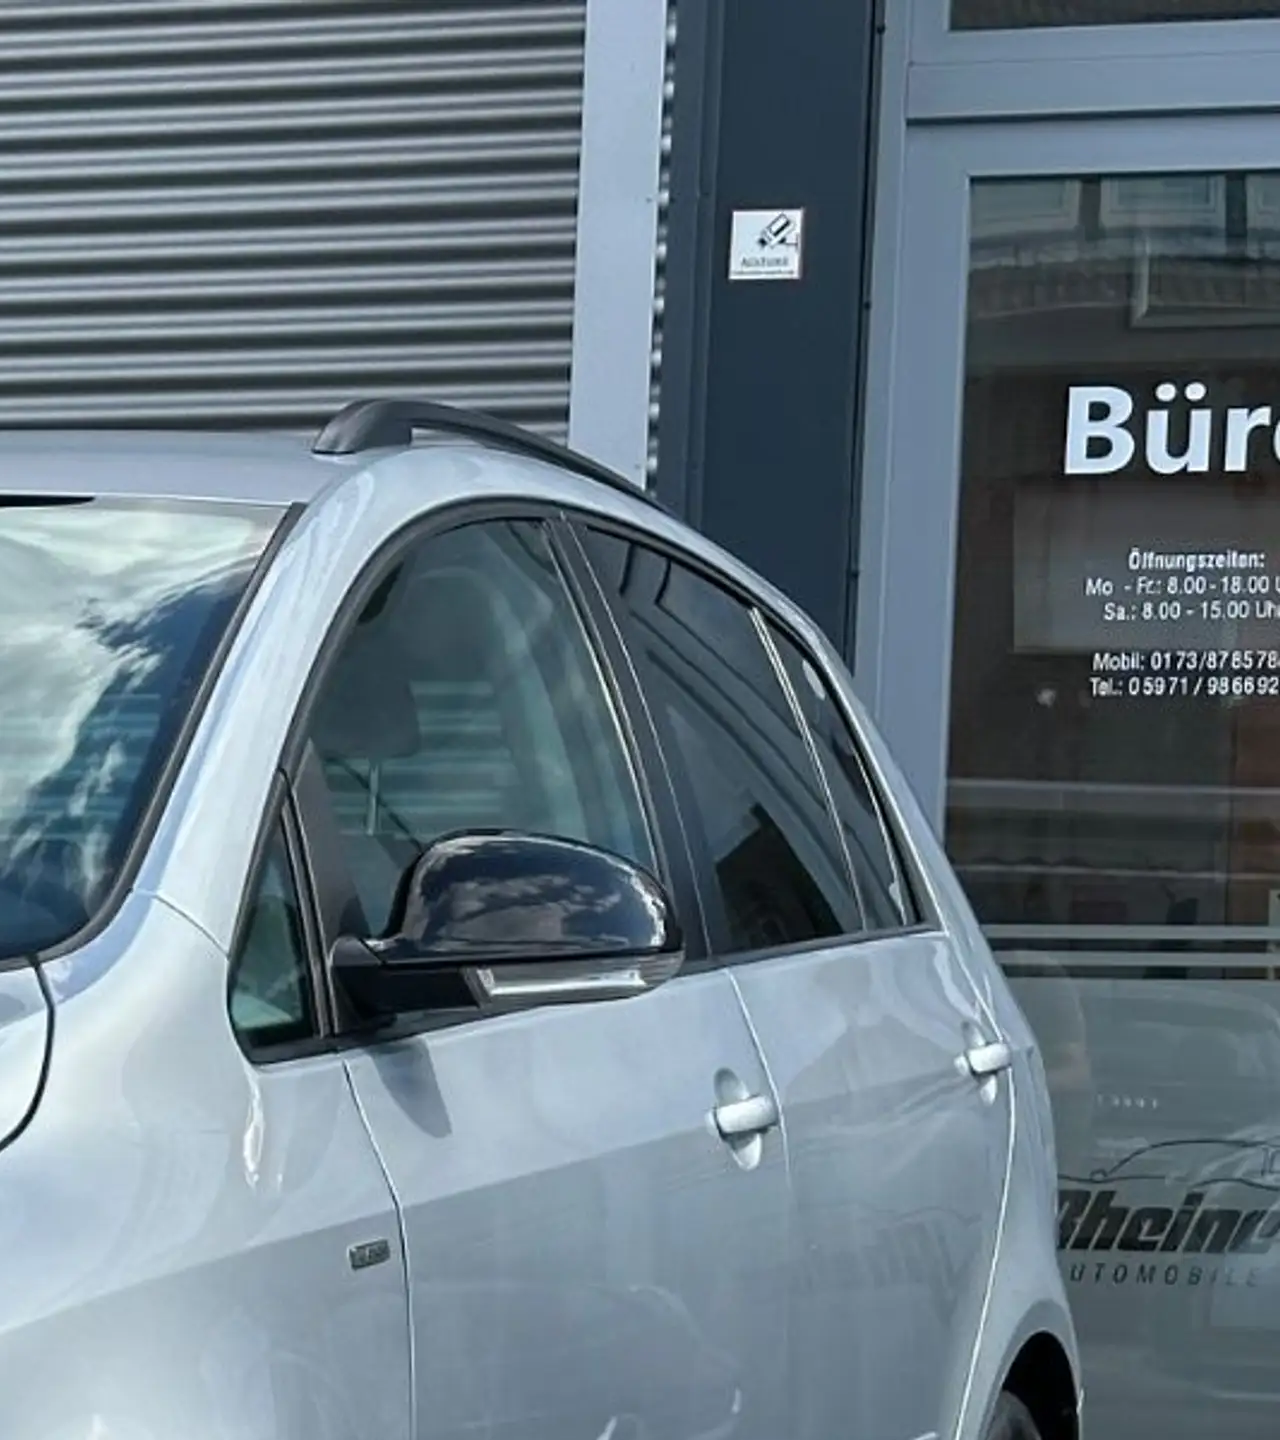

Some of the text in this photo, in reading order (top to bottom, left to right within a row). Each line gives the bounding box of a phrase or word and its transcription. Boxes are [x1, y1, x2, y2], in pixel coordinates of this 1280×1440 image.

[1064, 382, 1280, 475] Bür
[1092, 652, 1145, 671] Mobil:
[1089, 676, 1123, 697] Tel.:
[1192, 677, 1202, 696] /
[1068, 1262, 1260, 1288] UTOMOBILE
